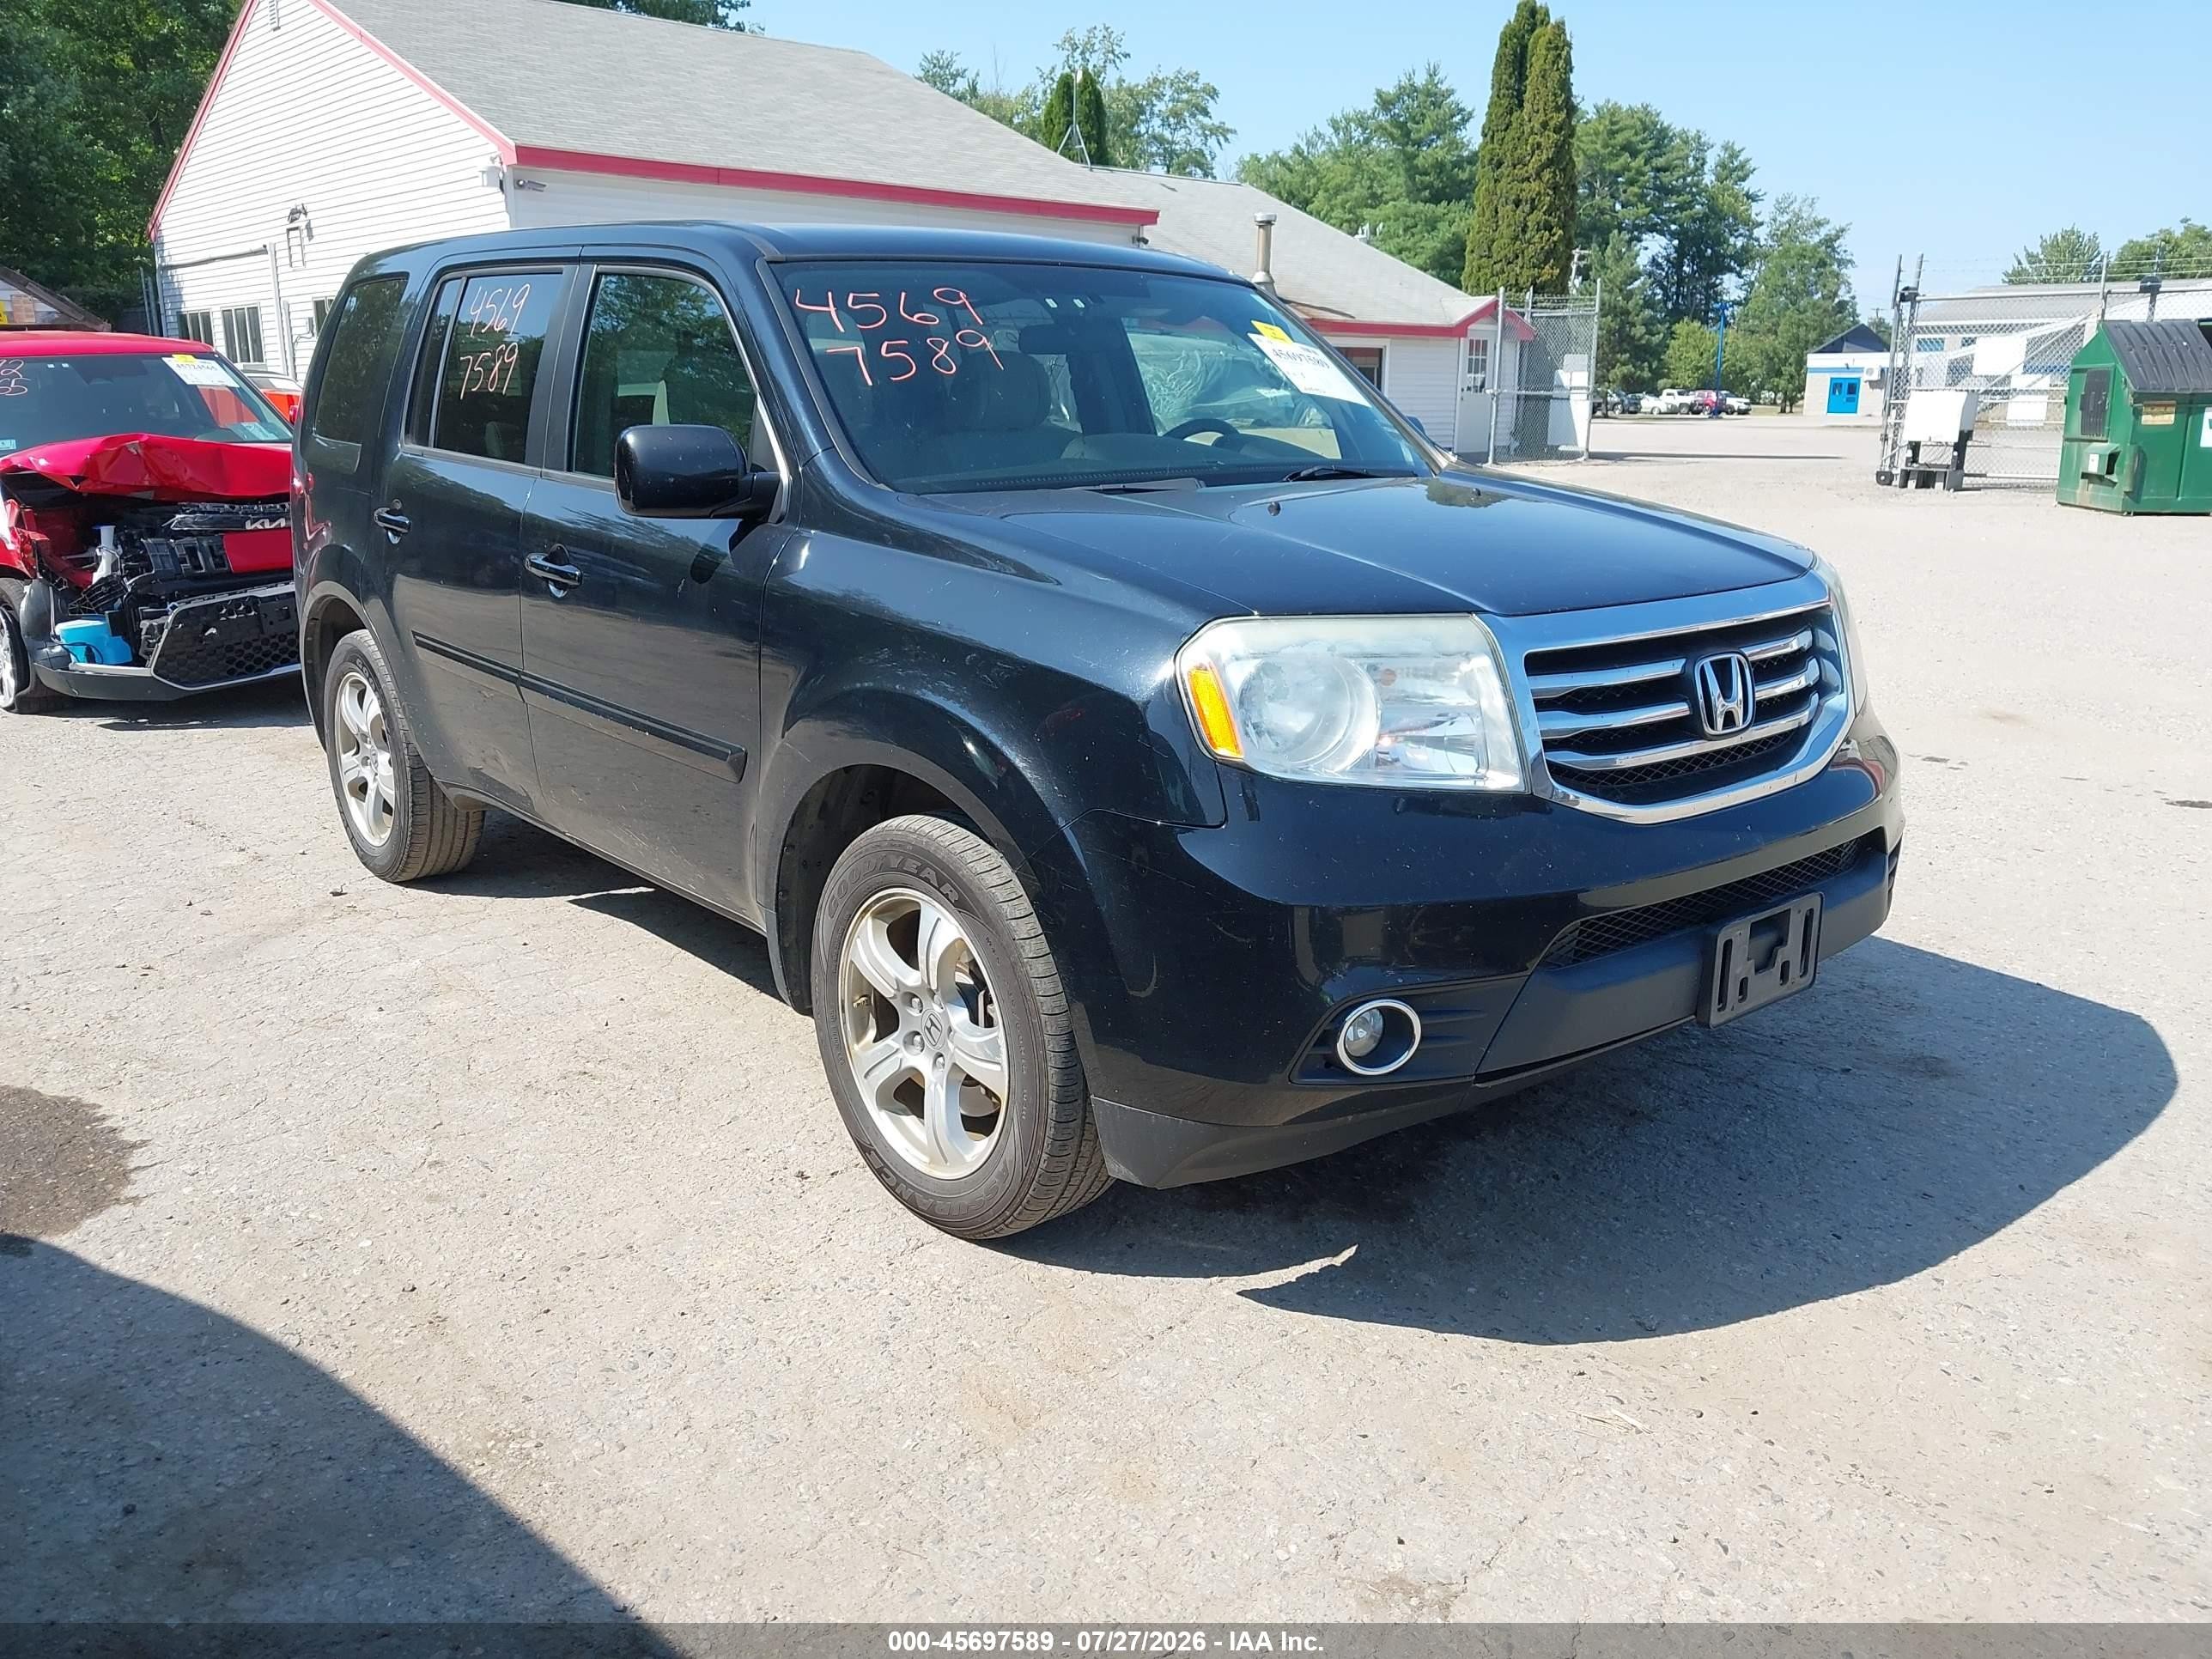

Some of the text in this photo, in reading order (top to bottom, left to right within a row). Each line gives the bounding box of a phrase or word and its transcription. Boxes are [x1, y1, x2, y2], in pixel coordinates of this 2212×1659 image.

[471, 283, 531, 337] 4569
[795, 287, 984, 333] 4569
[459, 342, 519, 400] 7589
[825, 329, 1005, 386] 7589
